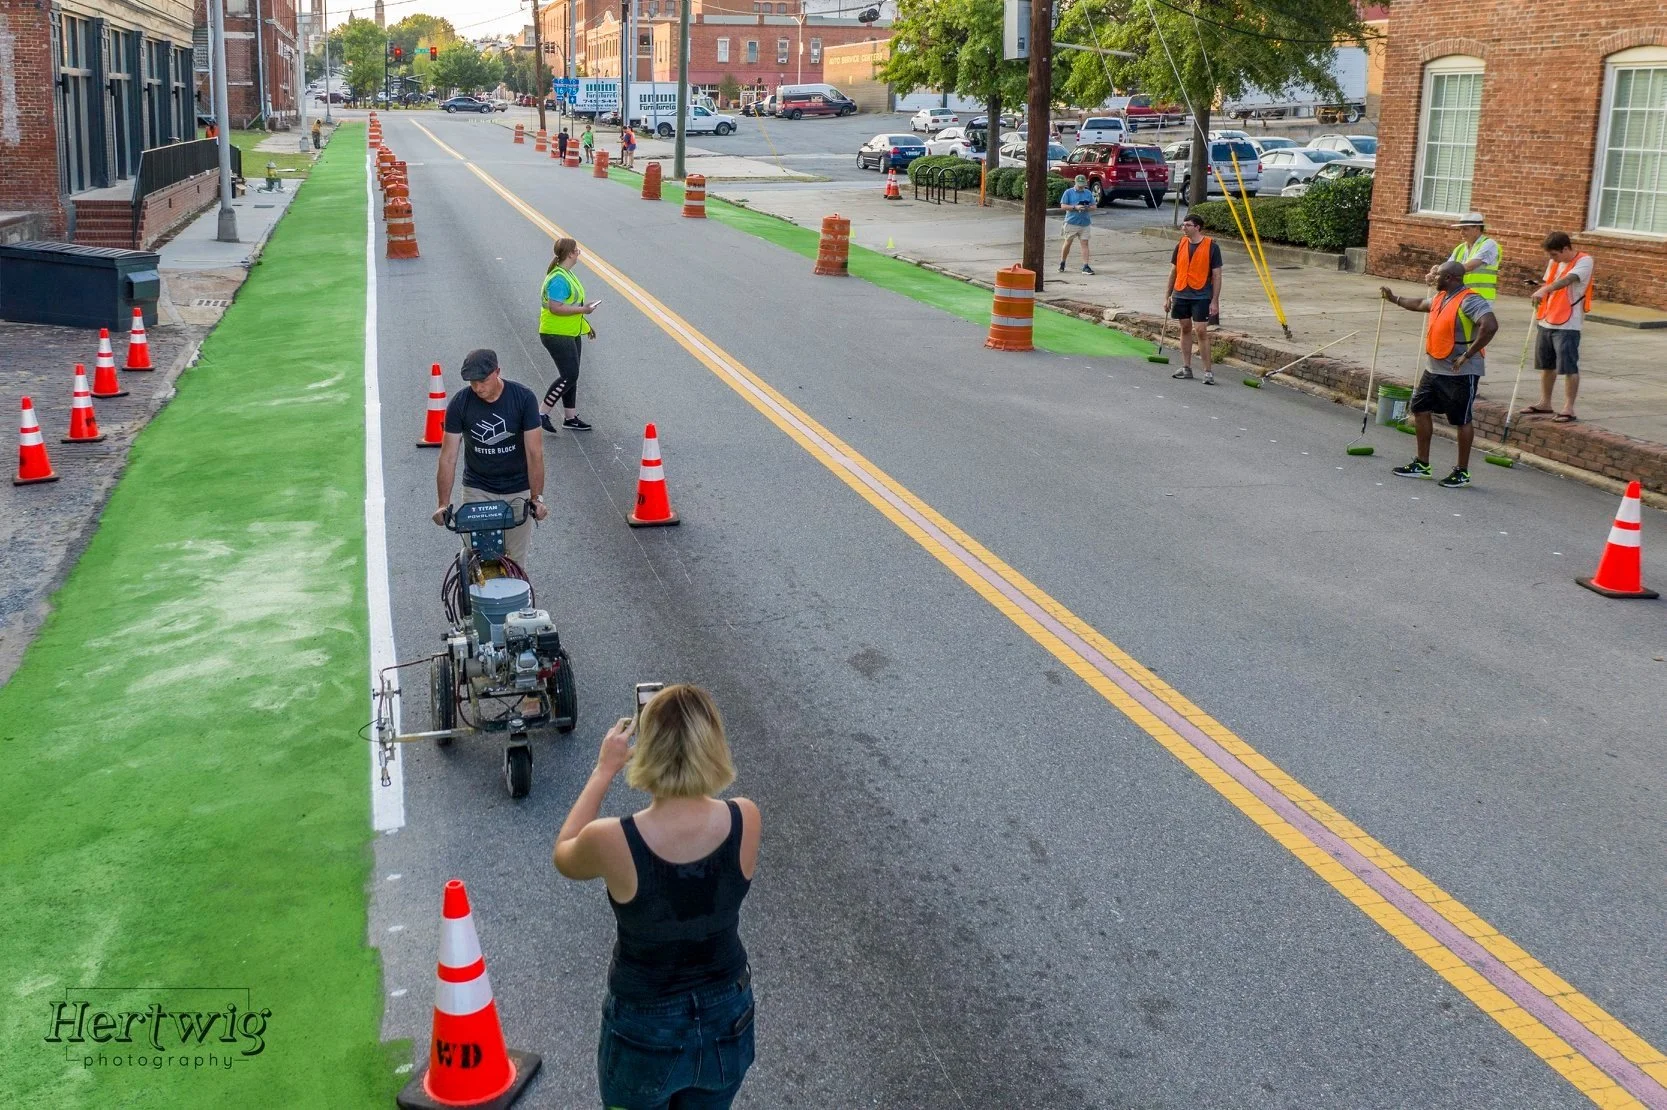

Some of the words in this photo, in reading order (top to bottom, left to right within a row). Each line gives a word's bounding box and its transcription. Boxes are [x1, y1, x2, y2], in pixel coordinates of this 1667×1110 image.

[841, 55, 860, 64] SERVICE
[474, 446, 496, 455] BETTER
[497, 444, 516, 454] BLOCK
